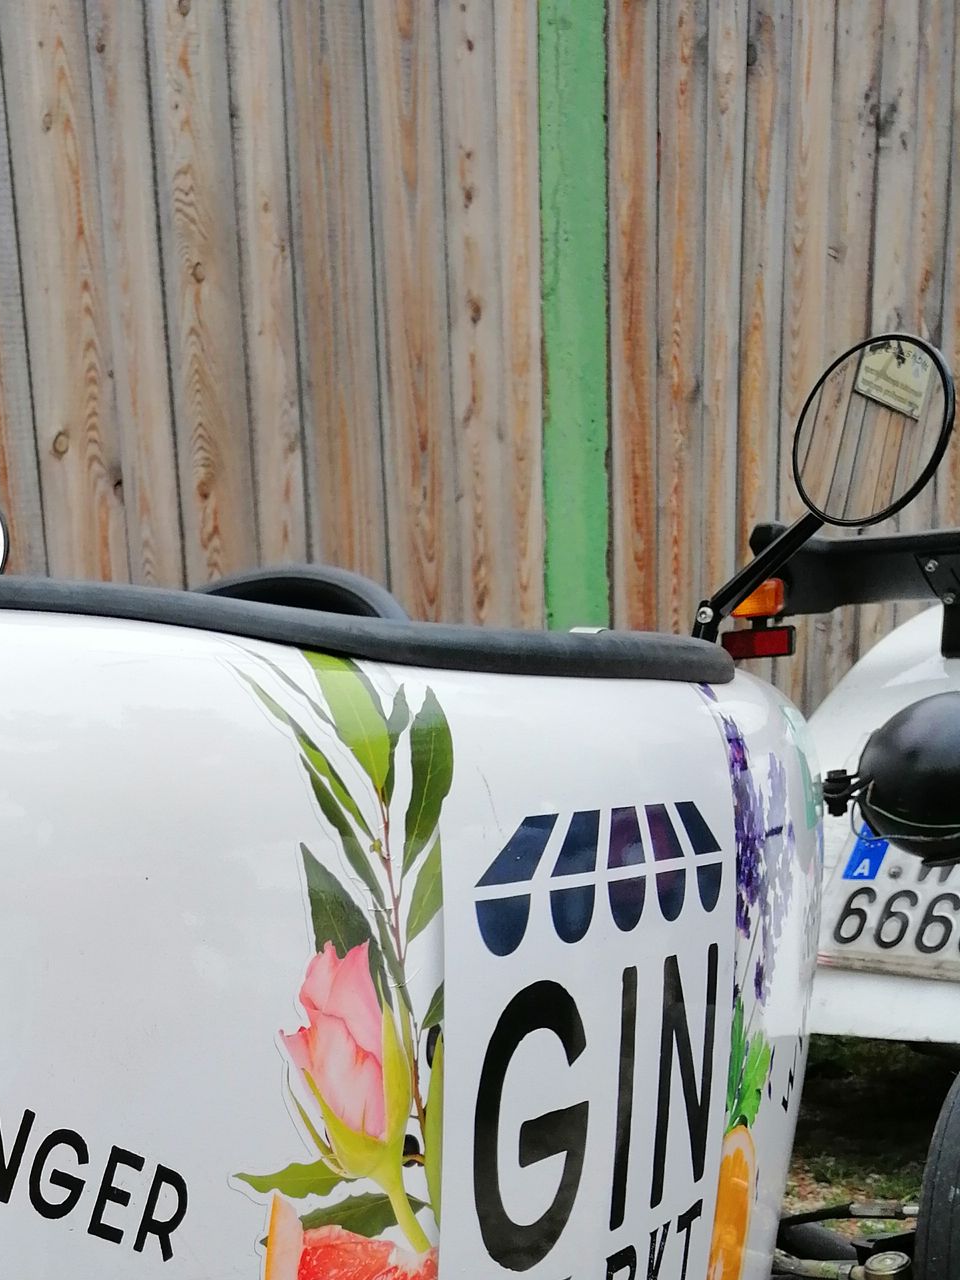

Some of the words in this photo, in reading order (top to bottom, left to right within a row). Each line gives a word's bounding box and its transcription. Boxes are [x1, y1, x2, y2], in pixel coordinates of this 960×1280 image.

[853, 858, 871, 877] A
[833, 886, 960, 954] 666
[473, 943, 719, 1274] GIN
